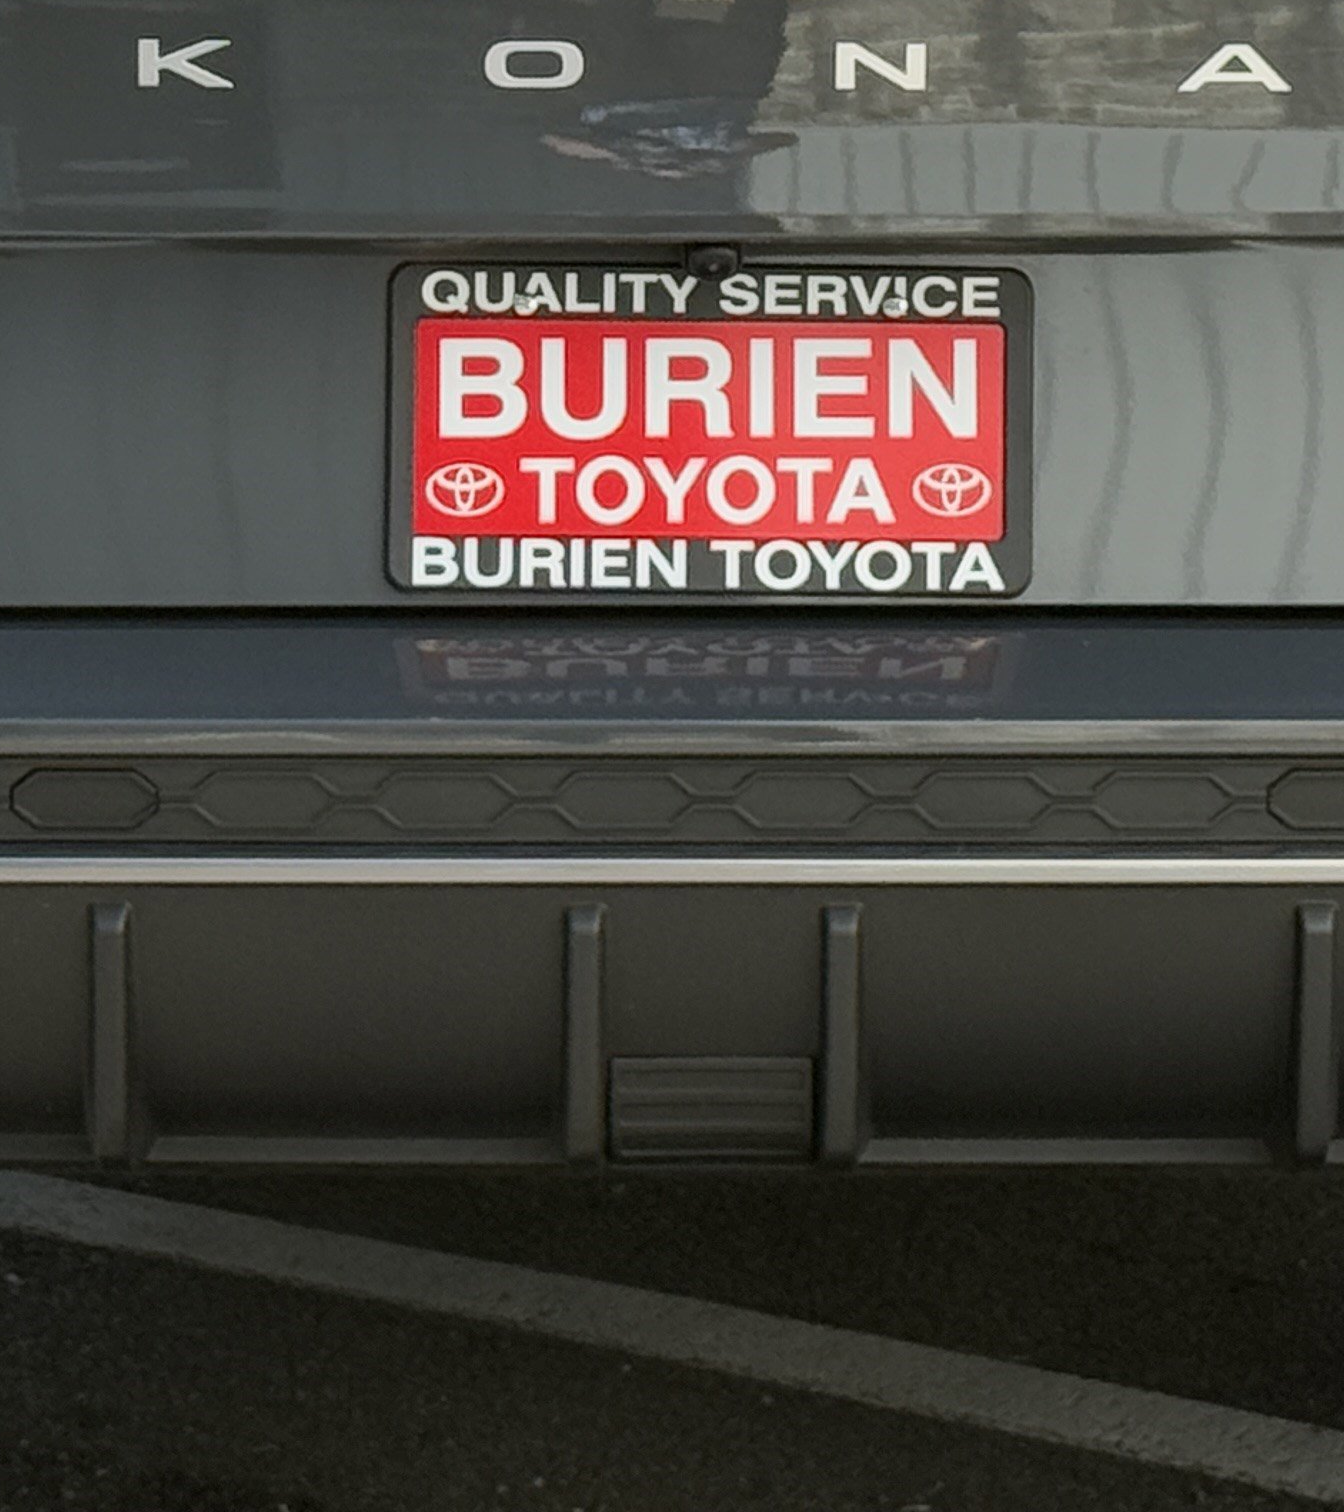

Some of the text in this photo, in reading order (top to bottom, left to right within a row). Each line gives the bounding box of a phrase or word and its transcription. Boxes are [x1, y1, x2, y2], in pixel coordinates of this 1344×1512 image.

[421, 270, 1001, 318] QUALITY SERVICE
[438, 336, 979, 440] BURIEN
[519, 455, 896, 526] TOYOTA
[411, 536, 1005, 591] BURIEN TOYOTA
